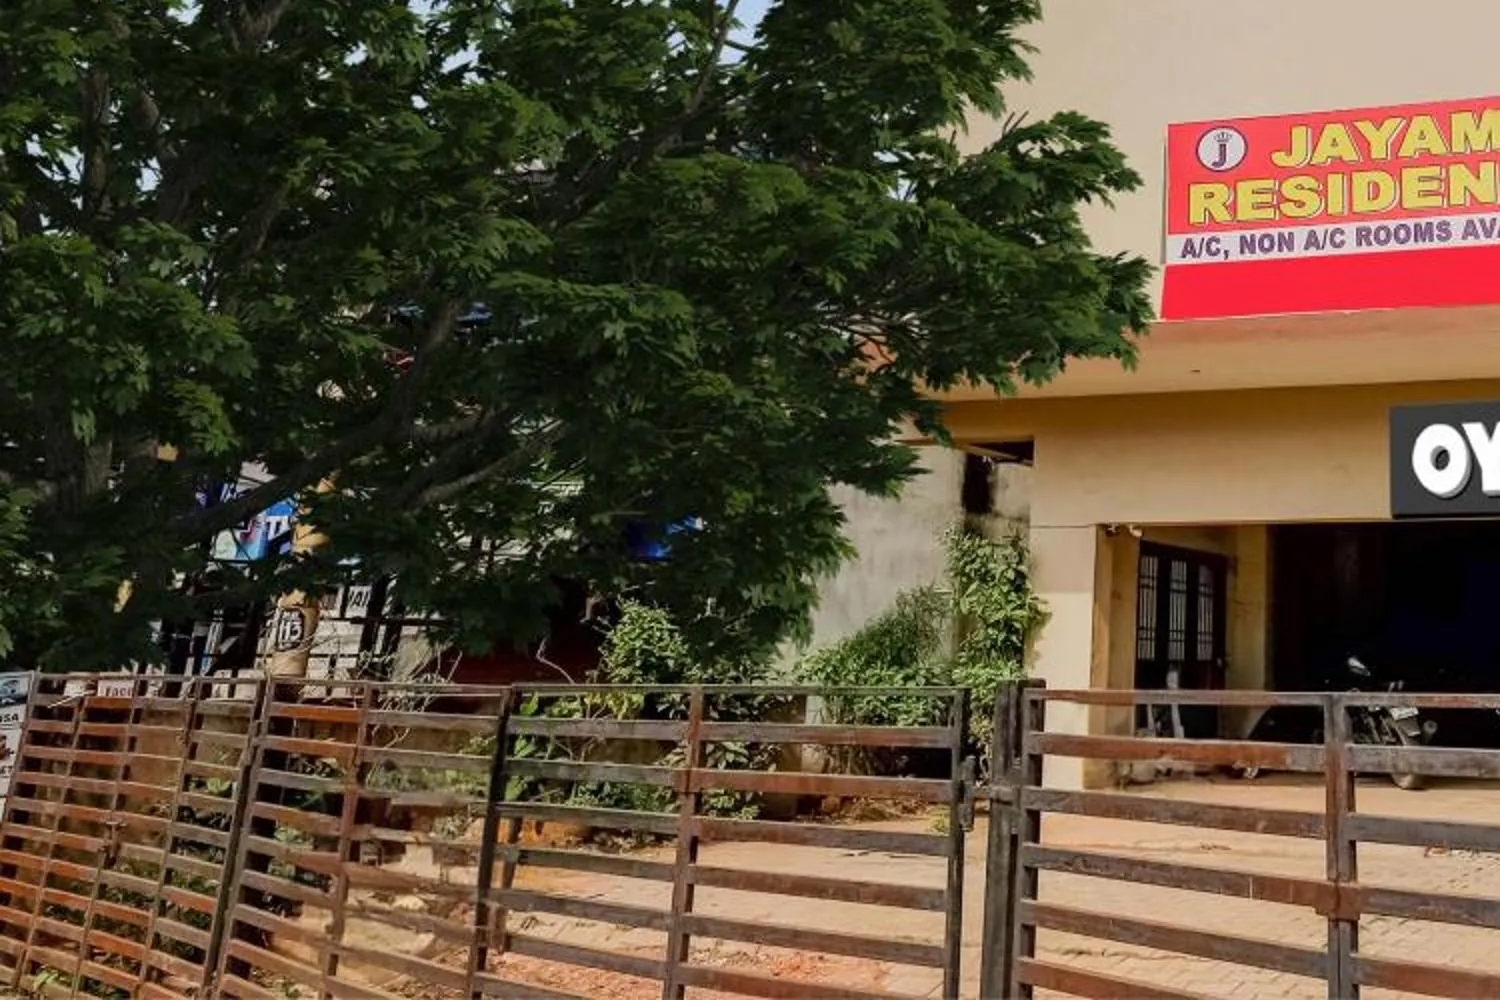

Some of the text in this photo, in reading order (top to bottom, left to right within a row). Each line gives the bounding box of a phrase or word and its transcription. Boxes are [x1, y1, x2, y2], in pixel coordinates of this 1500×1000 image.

[1181, 236, 1230, 260] A/C,
[1239, 232, 1295, 255] NON
[1303, 227, 1346, 251] A/C
[1355, 219, 1453, 247] ROOMS
